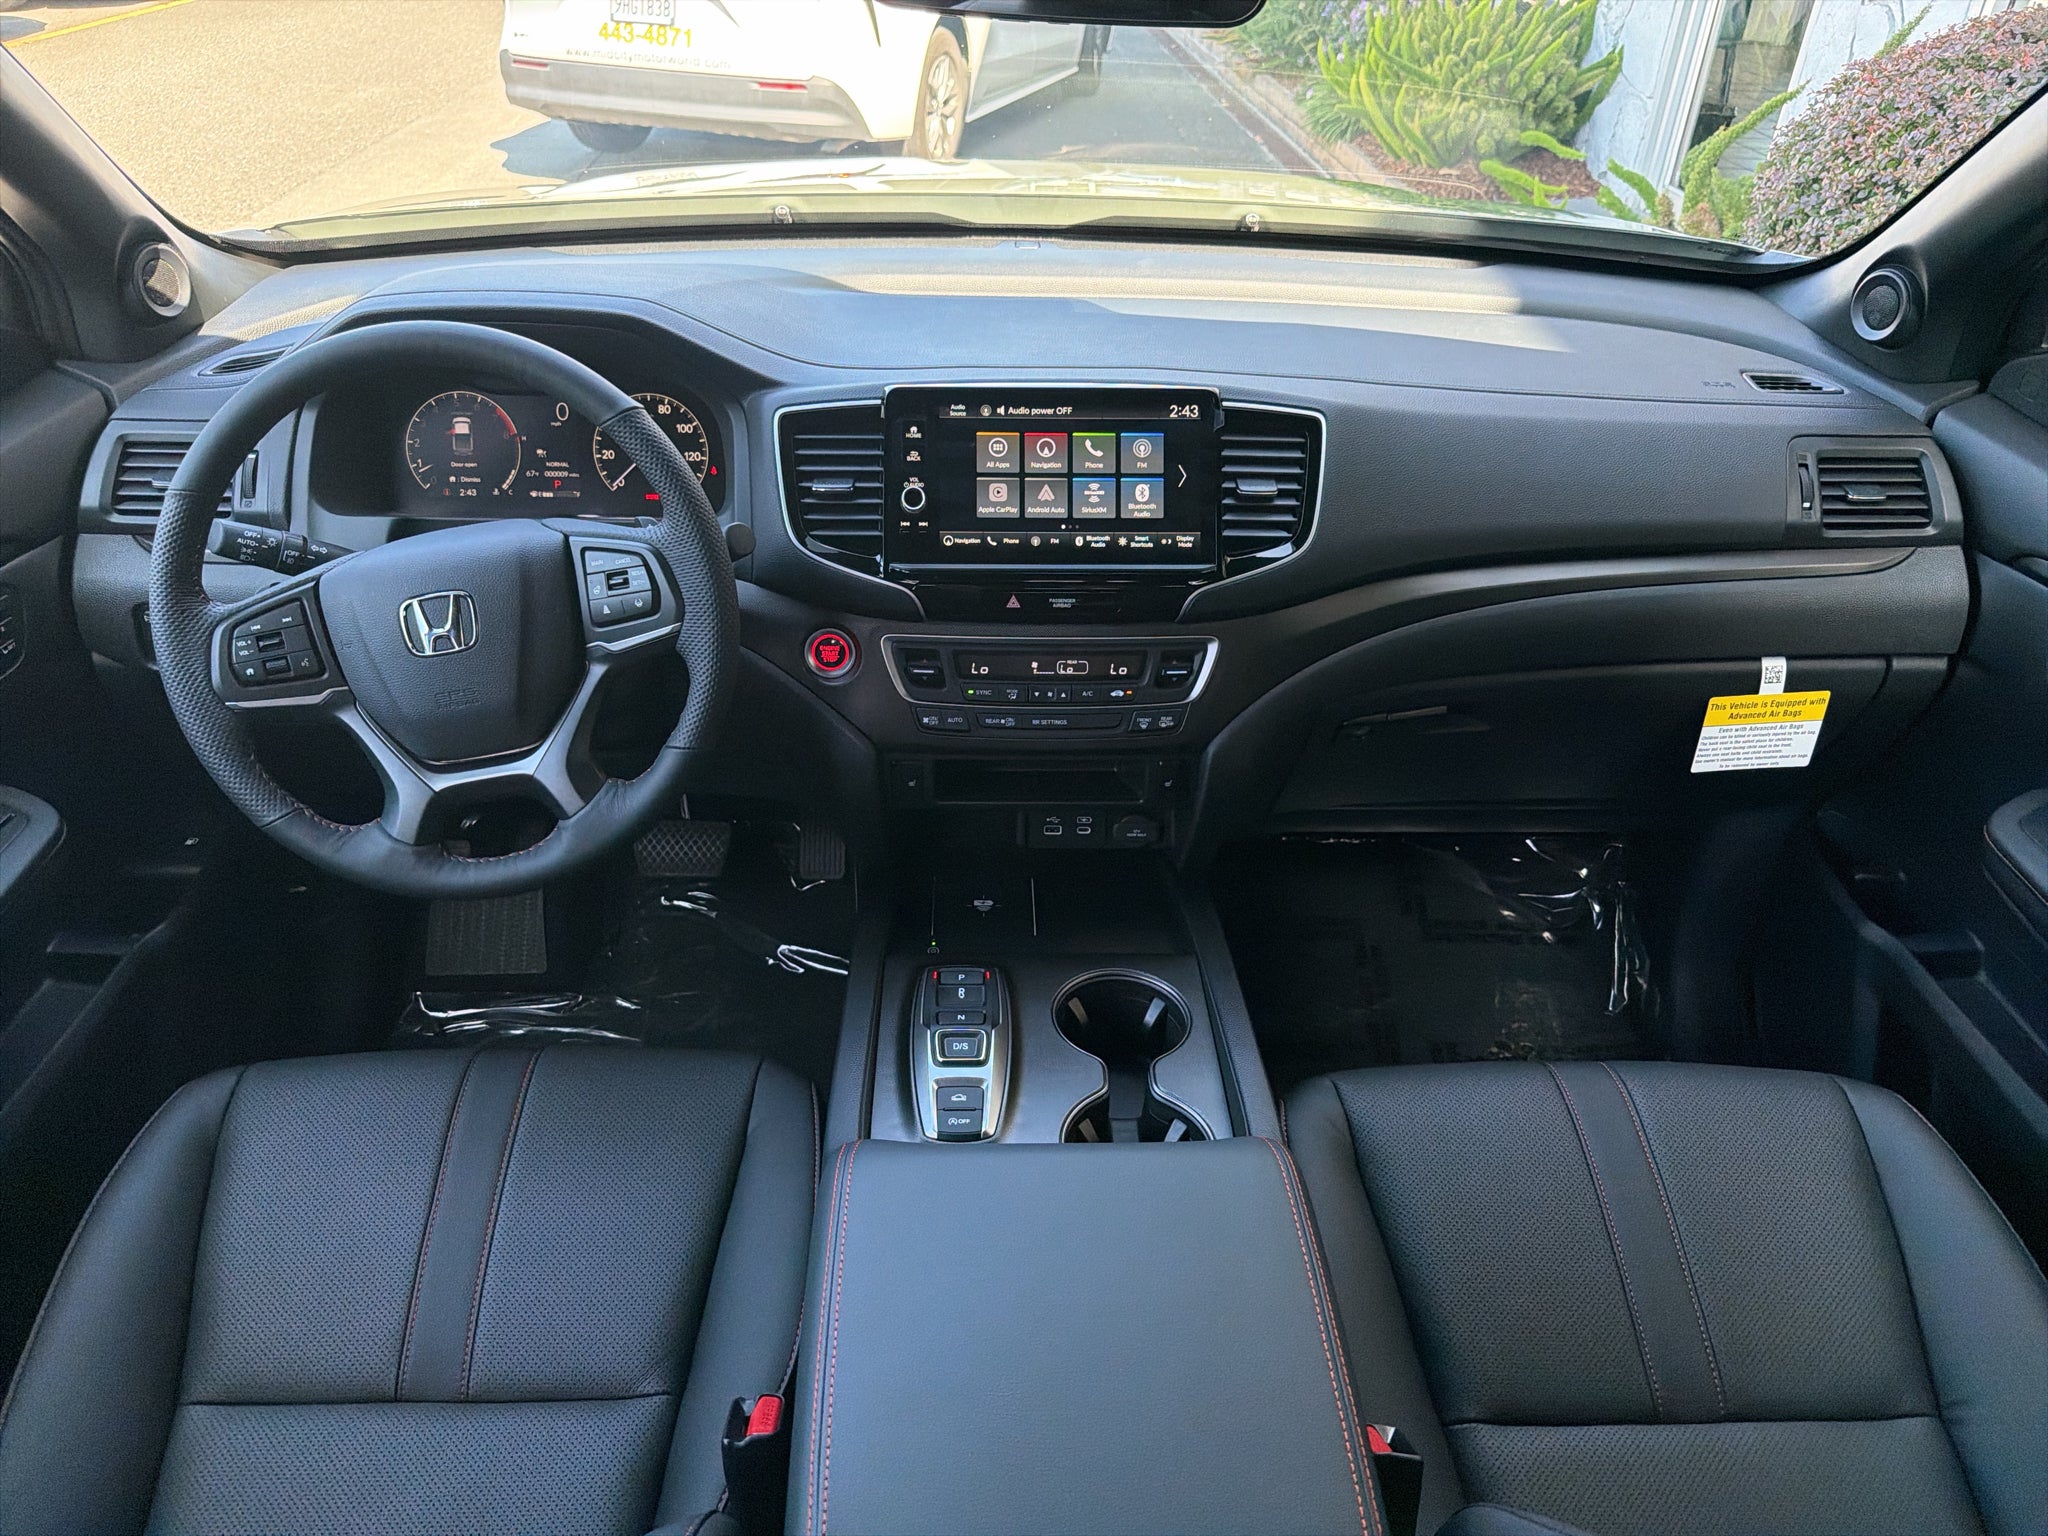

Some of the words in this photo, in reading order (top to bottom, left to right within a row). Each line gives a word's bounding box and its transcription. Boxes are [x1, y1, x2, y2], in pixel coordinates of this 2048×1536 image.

[599, 22, 691, 48] 443-4871
[556, 402, 569, 421] 0
[658, 405, 671, 414] 80
[1008, 407, 1029, 415] Audio
[1031, 408, 1054, 416] power
[1056, 407, 1073, 415] OFF
[1169, 404, 1199, 418] 2:43
[676, 424, 693, 433] 100
[414, 438, 420, 447] 2
[602, 450, 615, 459] 20
[684, 452, 701, 461] 120
[554, 480, 562, 489] P
[244, 530, 258, 538] OFF
[237, 538, 256, 546] AUTO
[287, 549, 300, 557] OFF
[971, 662, 989, 674] Lo
[1110, 663, 1127, 675] Lo
[1710, 703, 1727, 711] This
[1729, 701, 1758, 710] Vehicle
[1770, 698, 1807, 709] Equipped
[1728, 711, 1767, 720] Advanced
[1783, 709, 1802, 717] Bags
